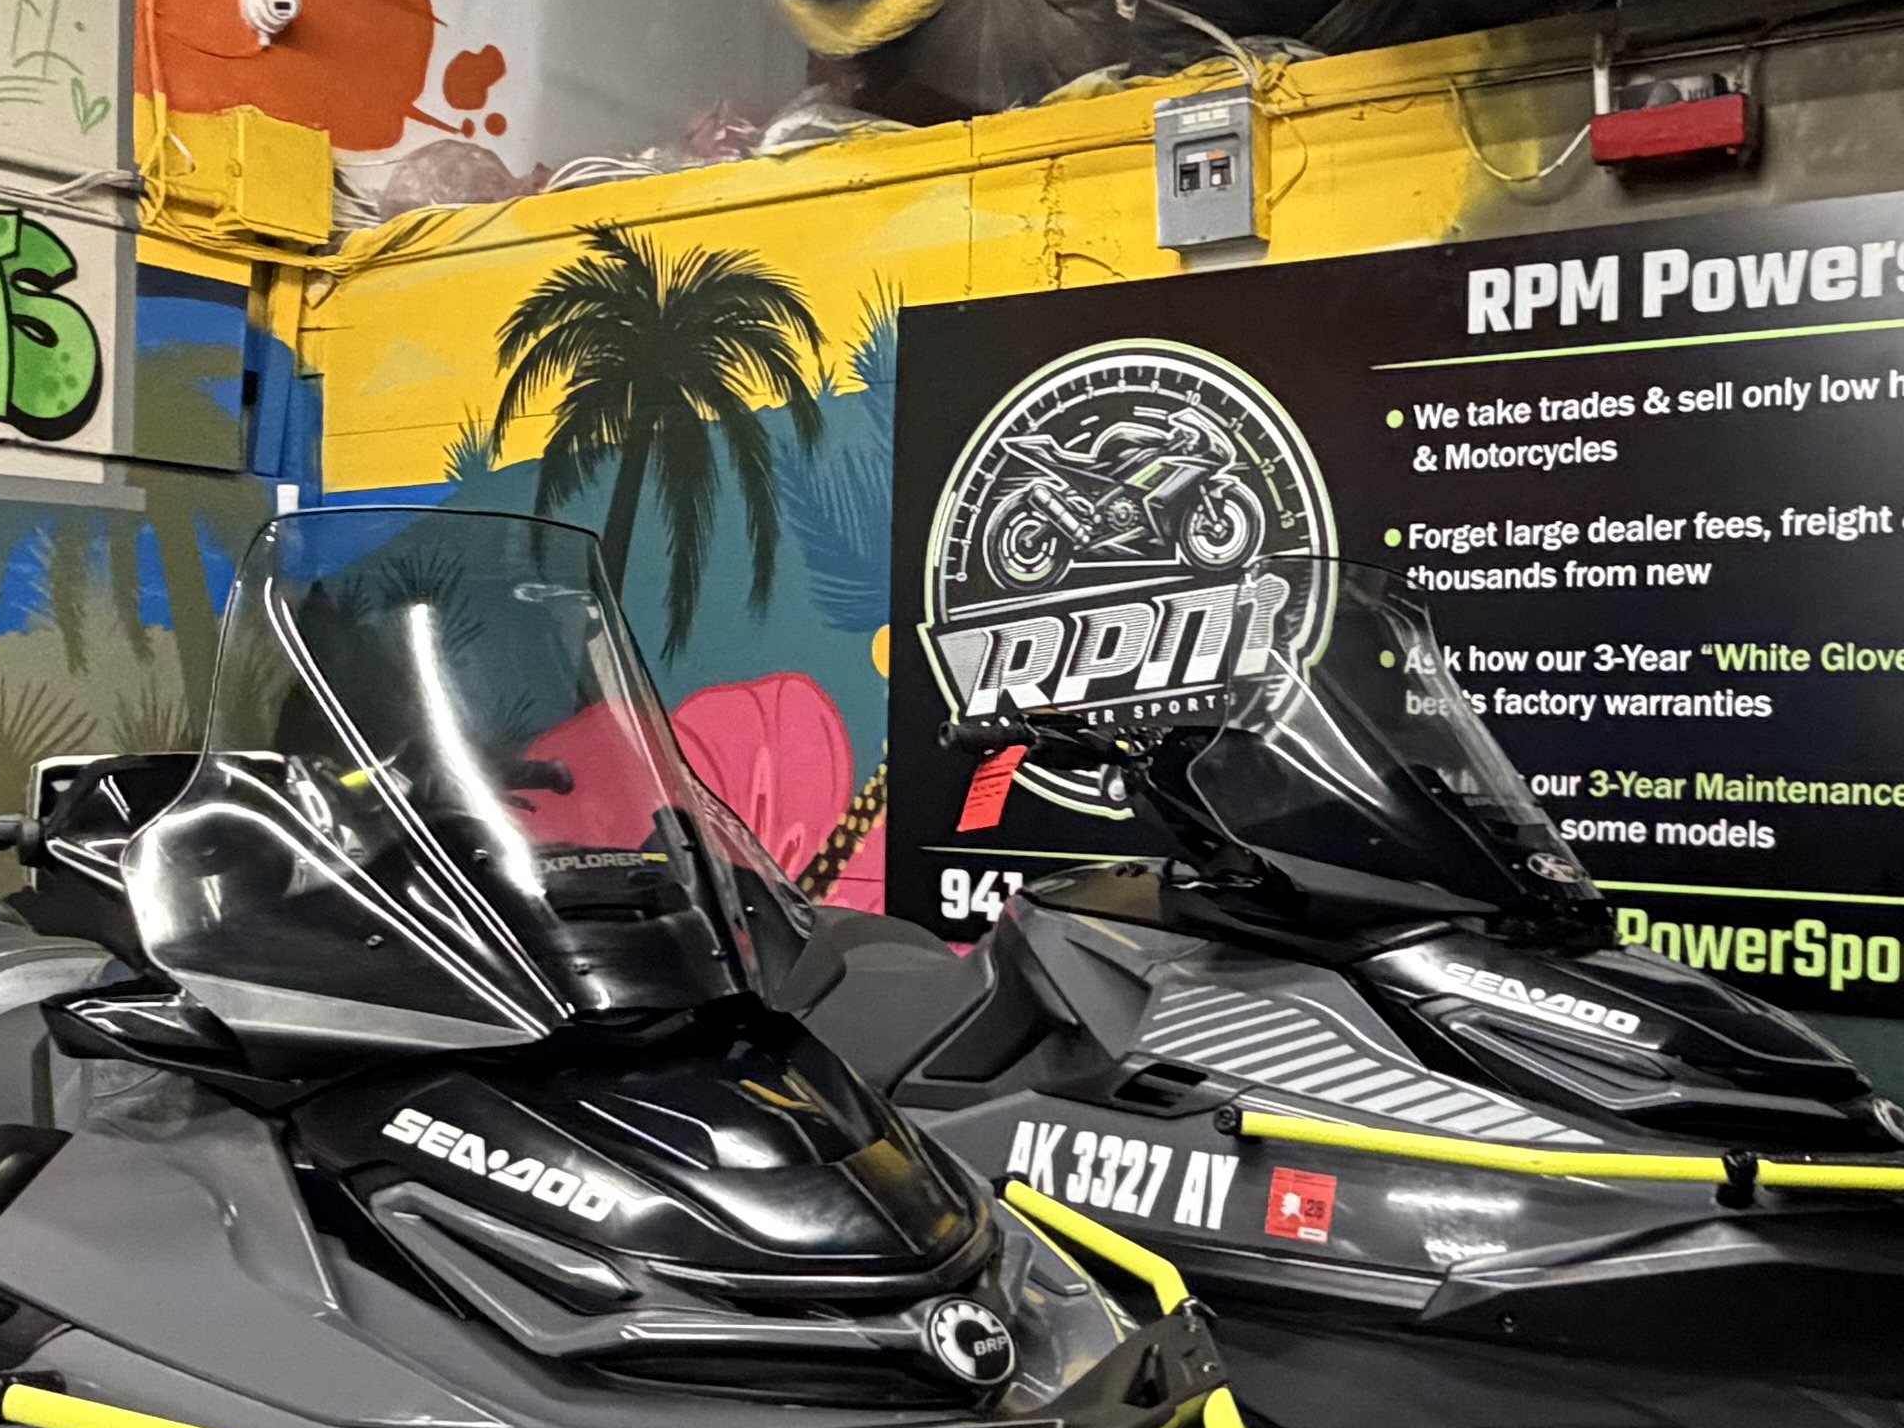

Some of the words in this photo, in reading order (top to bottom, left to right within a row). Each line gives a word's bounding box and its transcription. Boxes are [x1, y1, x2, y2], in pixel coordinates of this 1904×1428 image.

[1467, 254, 1620, 335] RPM
[1413, 403, 1460, 430] We
[1467, 398, 1531, 427] take
[1539, 392, 1636, 422] trades
[1643, 386, 1671, 415] &
[1677, 381, 1733, 413] sell
[1742, 376, 1813, 411] only
[1820, 375, 1879, 403] low
[1412, 446, 1439, 473] &
[1445, 436, 1618, 471] Motorcycles
[1408, 521, 1497, 554] Forget
[1505, 518, 1581, 551] large
[1587, 514, 1685, 546] dealer
[1693, 511, 1772, 544] fees,
[1780, 504, 1894, 542] freight
[1406, 561, 1558, 592] thousands
[1564, 560, 1638, 590] from
[1646, 560, 1713, 587] new
[1469, 645, 1529, 673] how
[1536, 650, 1587, 673] our
[1593, 643, 1693, 673] 3-Year
[1406, 688, 1488, 718] beas
[1494, 687, 1596, 722] factory
[1604, 689, 1773, 719] warranties
[1530, 772, 1583, 798] our
[1587, 768, 1687, 800] 3-Year
[1560, 818, 1647, 844] some
[1654, 818, 1777, 850] models
[1006, 1121, 1068, 1197] AK
[1065, 1130, 1174, 1219] 3327
[1173, 1150, 1240, 1231] AY
[973, 1335, 1009, 1357] BRP
